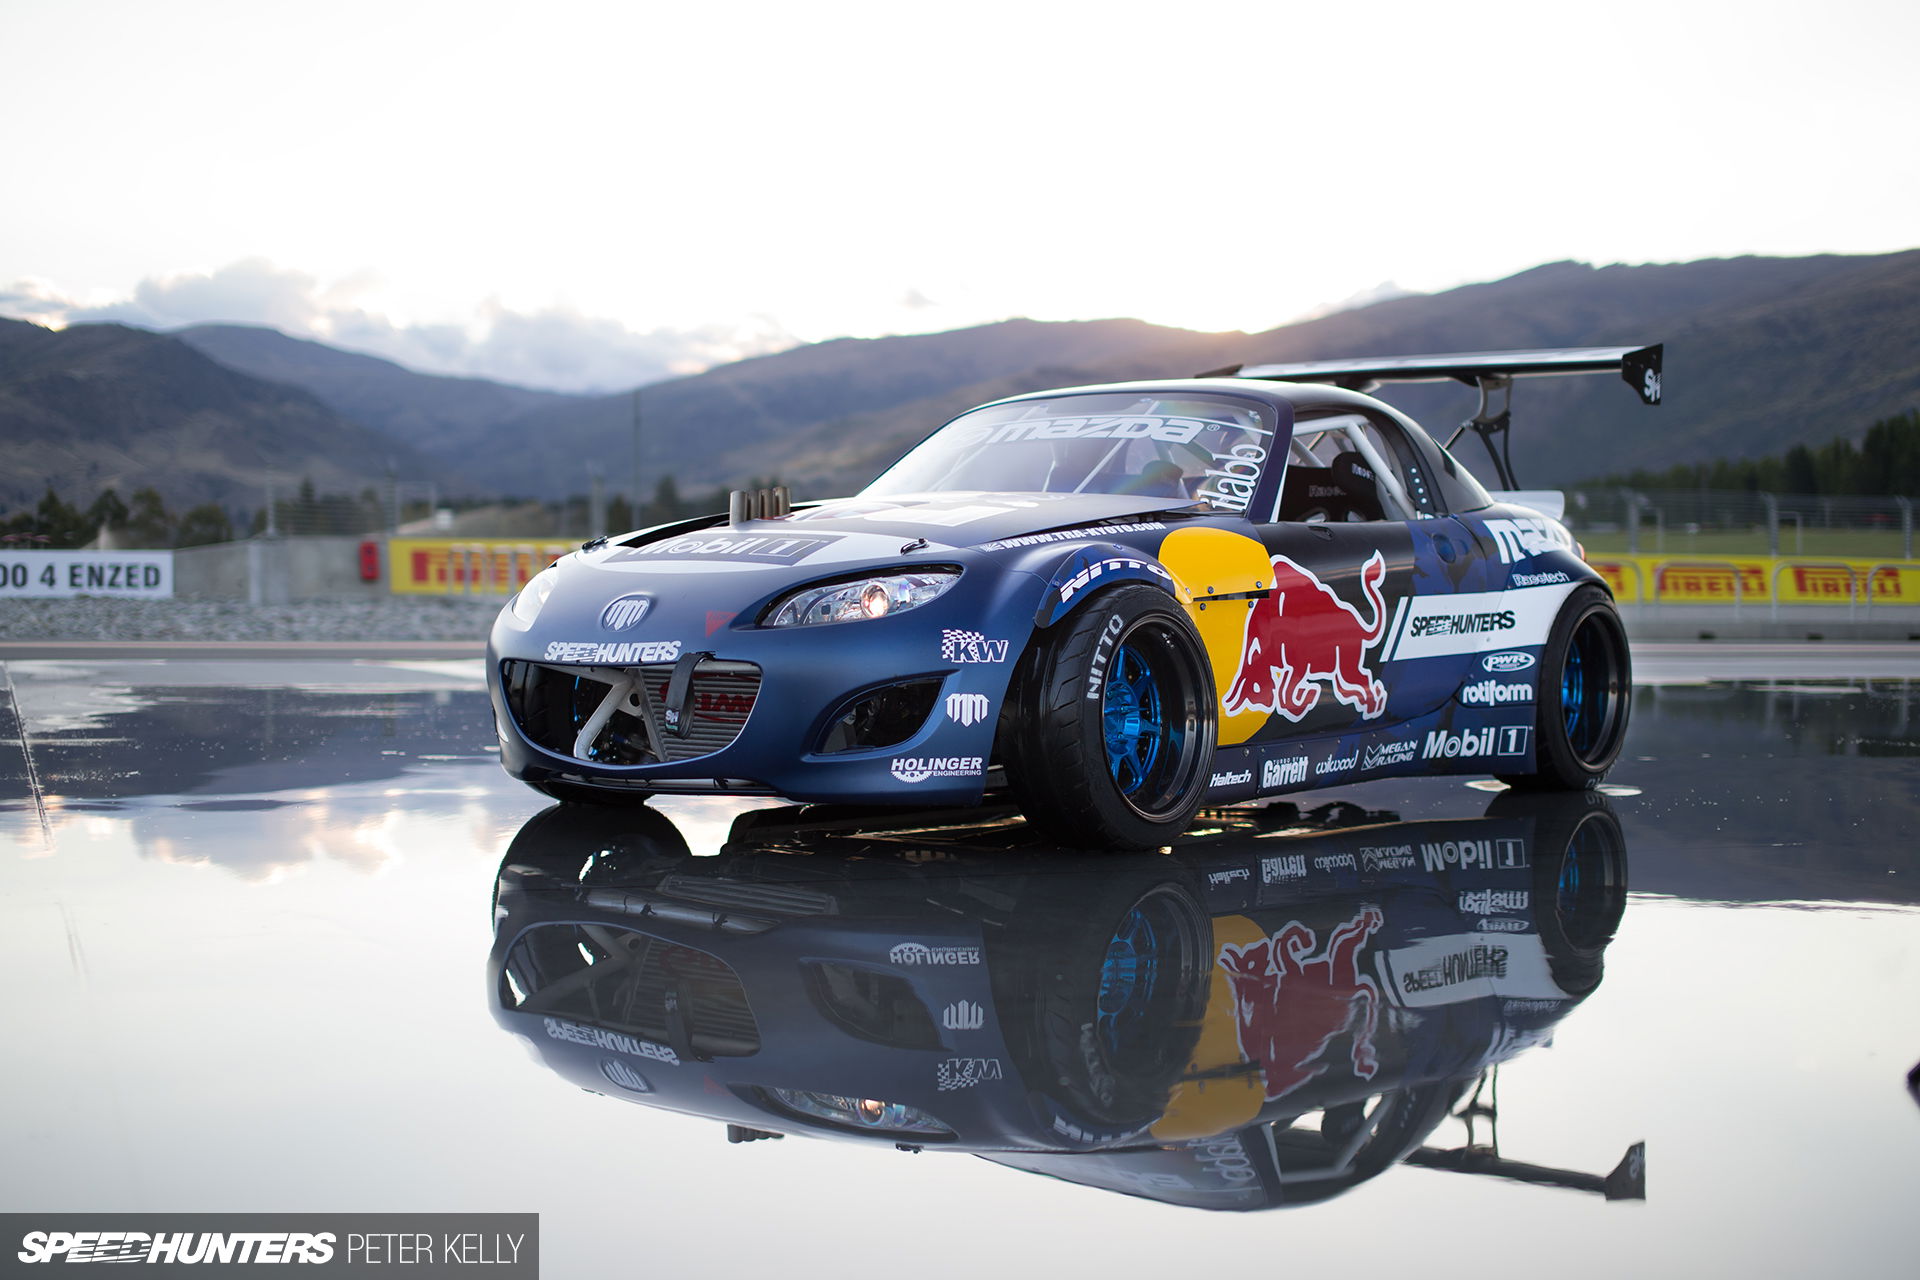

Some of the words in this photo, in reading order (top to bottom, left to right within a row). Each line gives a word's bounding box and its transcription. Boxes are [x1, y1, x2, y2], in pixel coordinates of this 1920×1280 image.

[627, 537, 769, 556] Mobil
[999, 522, 1167, 549] WWW.TRA-KYOTO.COM
[39, 563, 56, 588] 4
[69, 563, 161, 588] ENZED
[1060, 558, 1172, 603] NITTO
[1656, 565, 1765, 596] PIRELLI
[1792, 564, 1902, 597] PIRELLI
[1410, 610, 1516, 637] SPEEDHUNTERS
[544, 640, 682, 663] SPEEDHUNTERS
[952, 639, 1010, 663] KW
[1087, 614, 1123, 699] NITTO
[1462, 680, 1533, 706] rotiform
[1381, 740, 1418, 754] MEGAN
[1422, 727, 1495, 759] Mobil
[891, 757, 983, 771] HOLINGER
[1377, 751, 1414, 767] RACING
[933, 769, 982, 777] ENGINEERING
[1210, 770, 1252, 787] Haltech
[1263, 756, 1309, 788] Garrett
